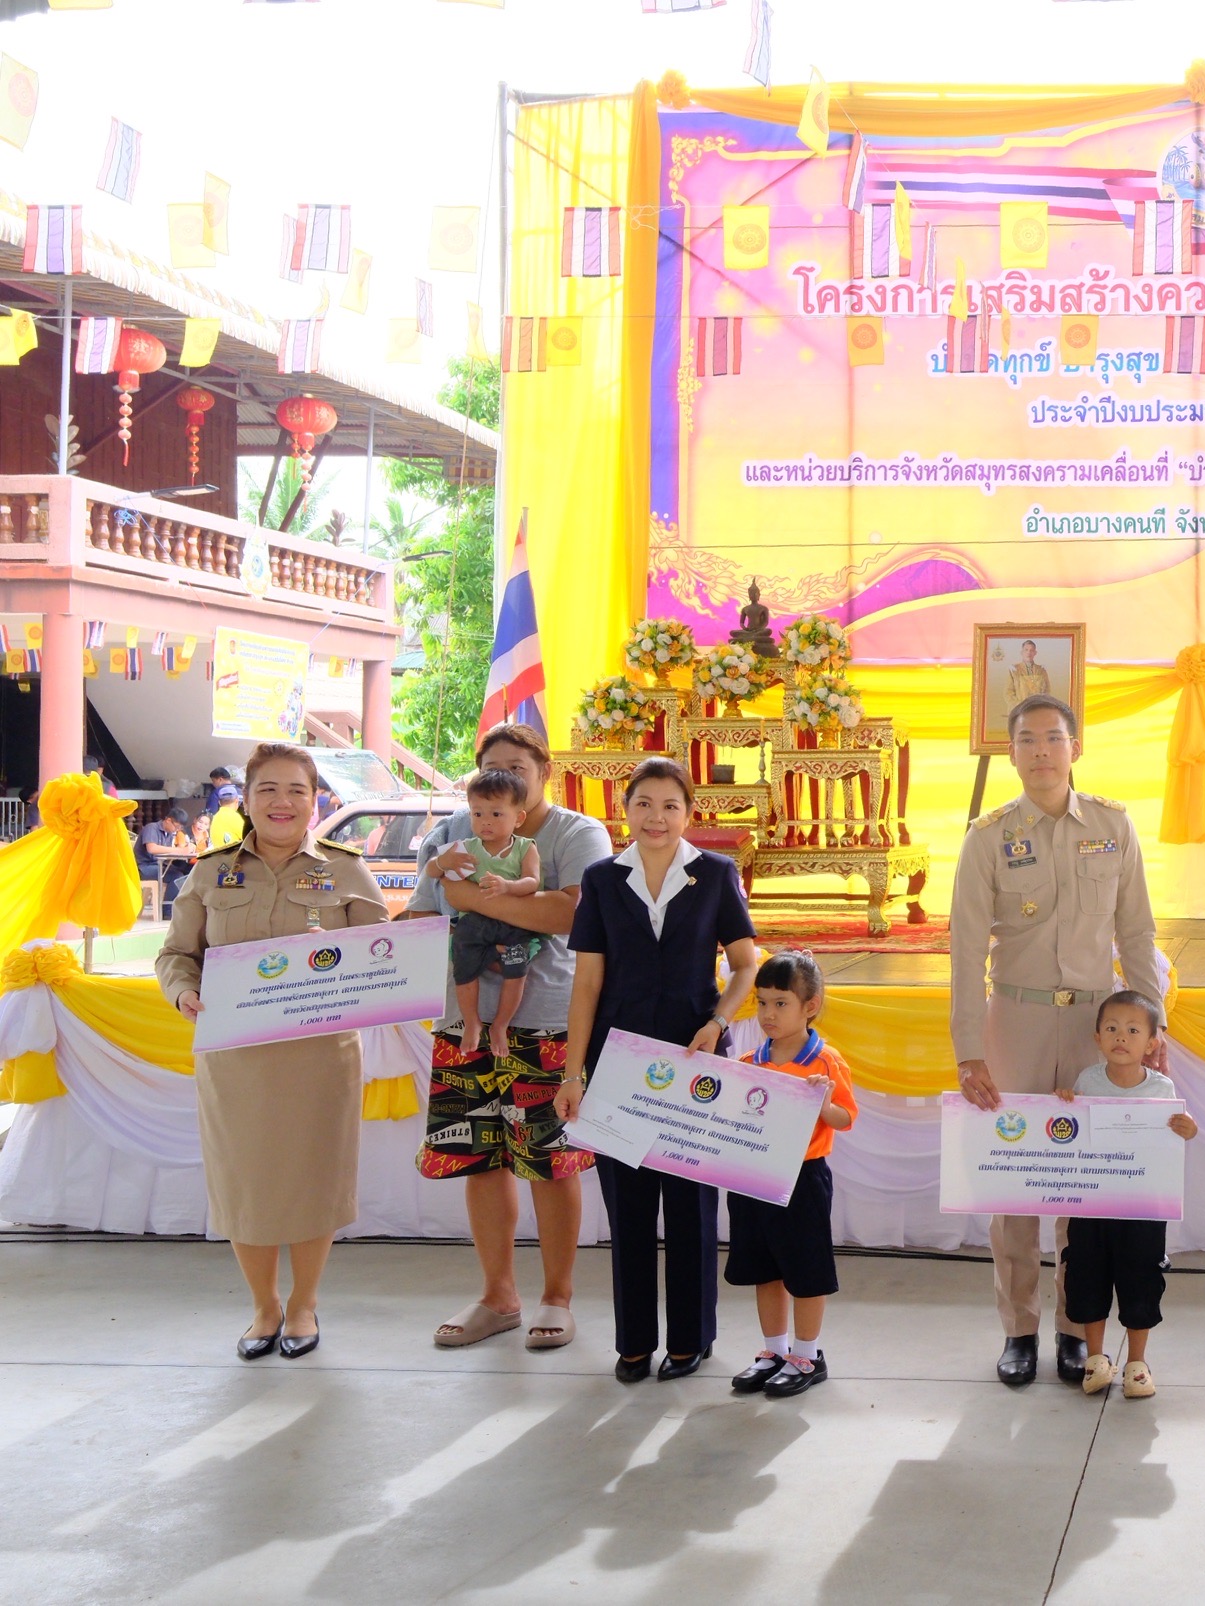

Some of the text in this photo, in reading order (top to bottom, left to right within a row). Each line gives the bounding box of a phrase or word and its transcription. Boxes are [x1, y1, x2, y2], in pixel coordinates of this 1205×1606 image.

[745, 452, 1169, 490] และหน่วยบริการจังหวัดสมุทรสงครามเคลื่อนที่
